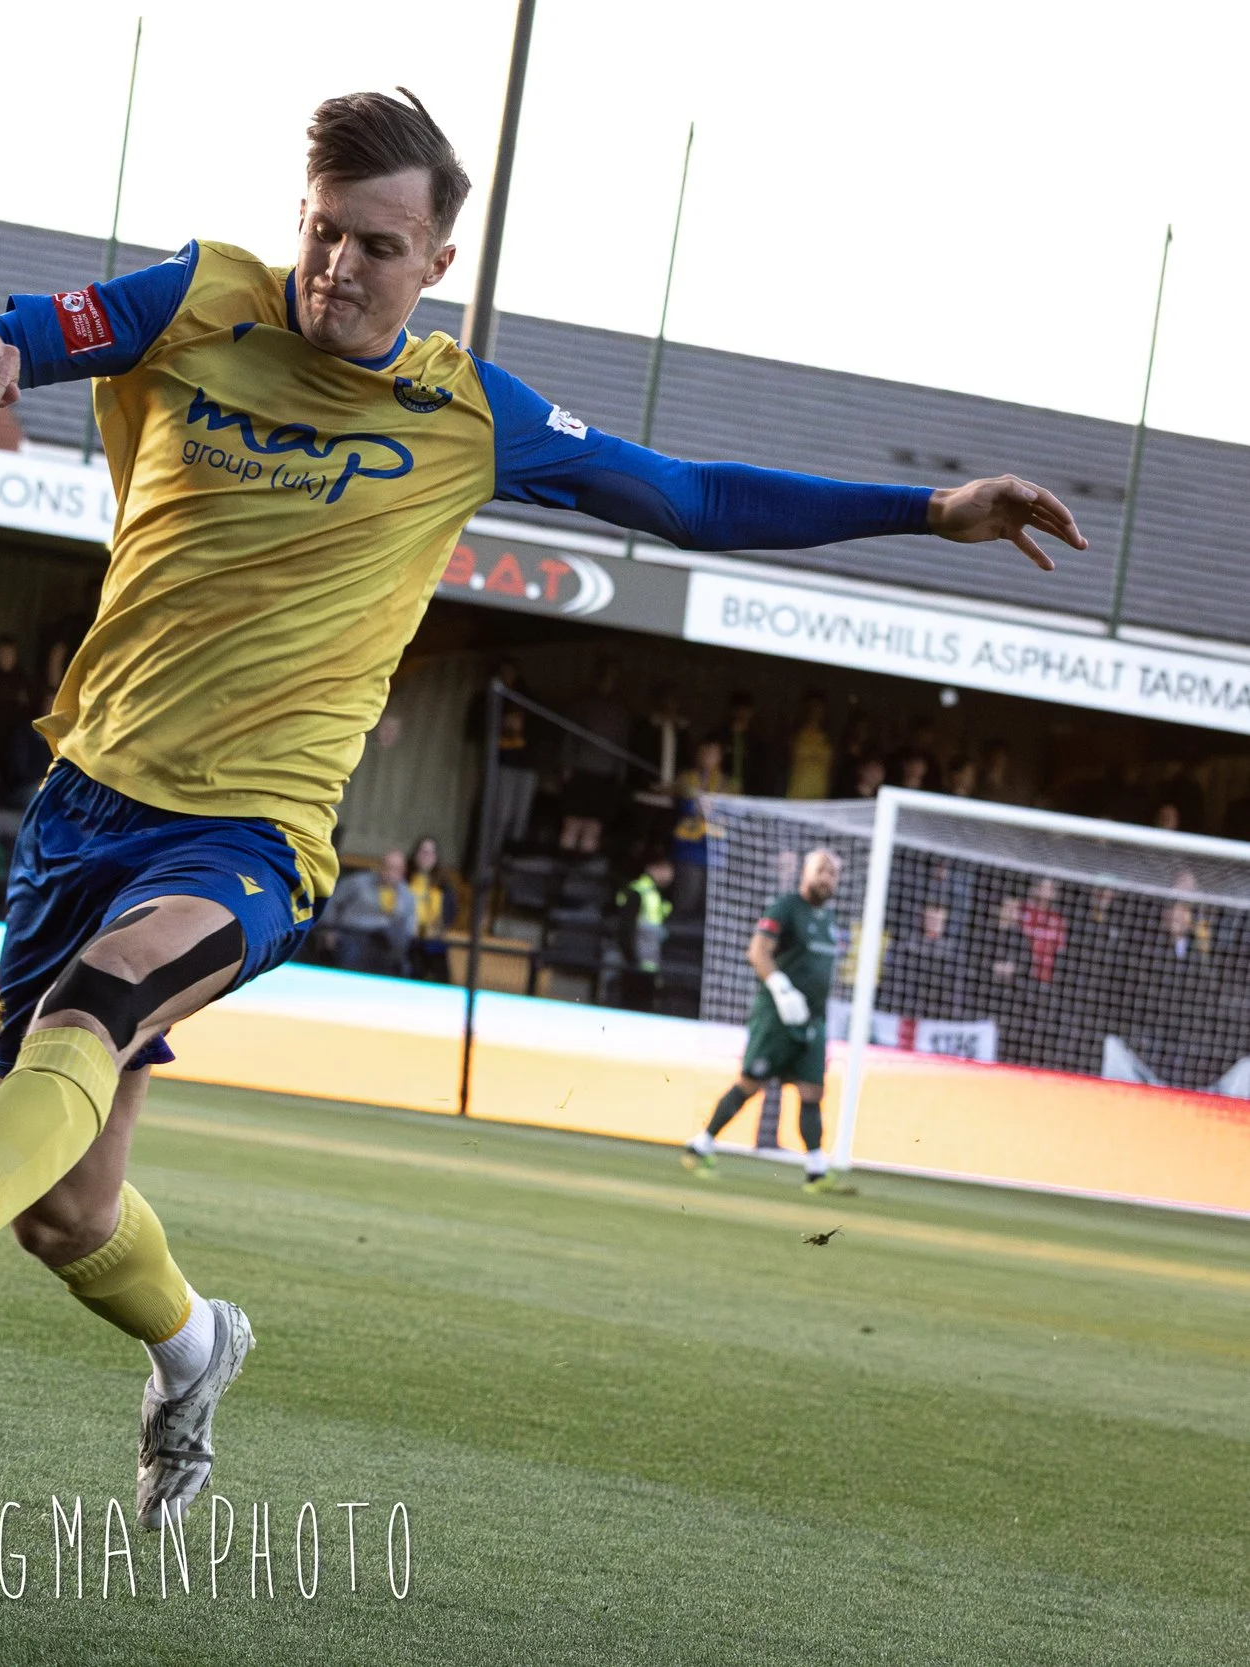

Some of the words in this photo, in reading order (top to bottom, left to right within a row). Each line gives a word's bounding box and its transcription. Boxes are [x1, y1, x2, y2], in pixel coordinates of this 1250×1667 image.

[94, 318, 106, 338] WITH
[181, 439, 263, 482] group
[271, 464, 327, 500] (uk)
[186, 386, 415, 504] map
[721, 593, 961, 666] BROWNHILLS
[971, 639, 1128, 692] ASPHALT
